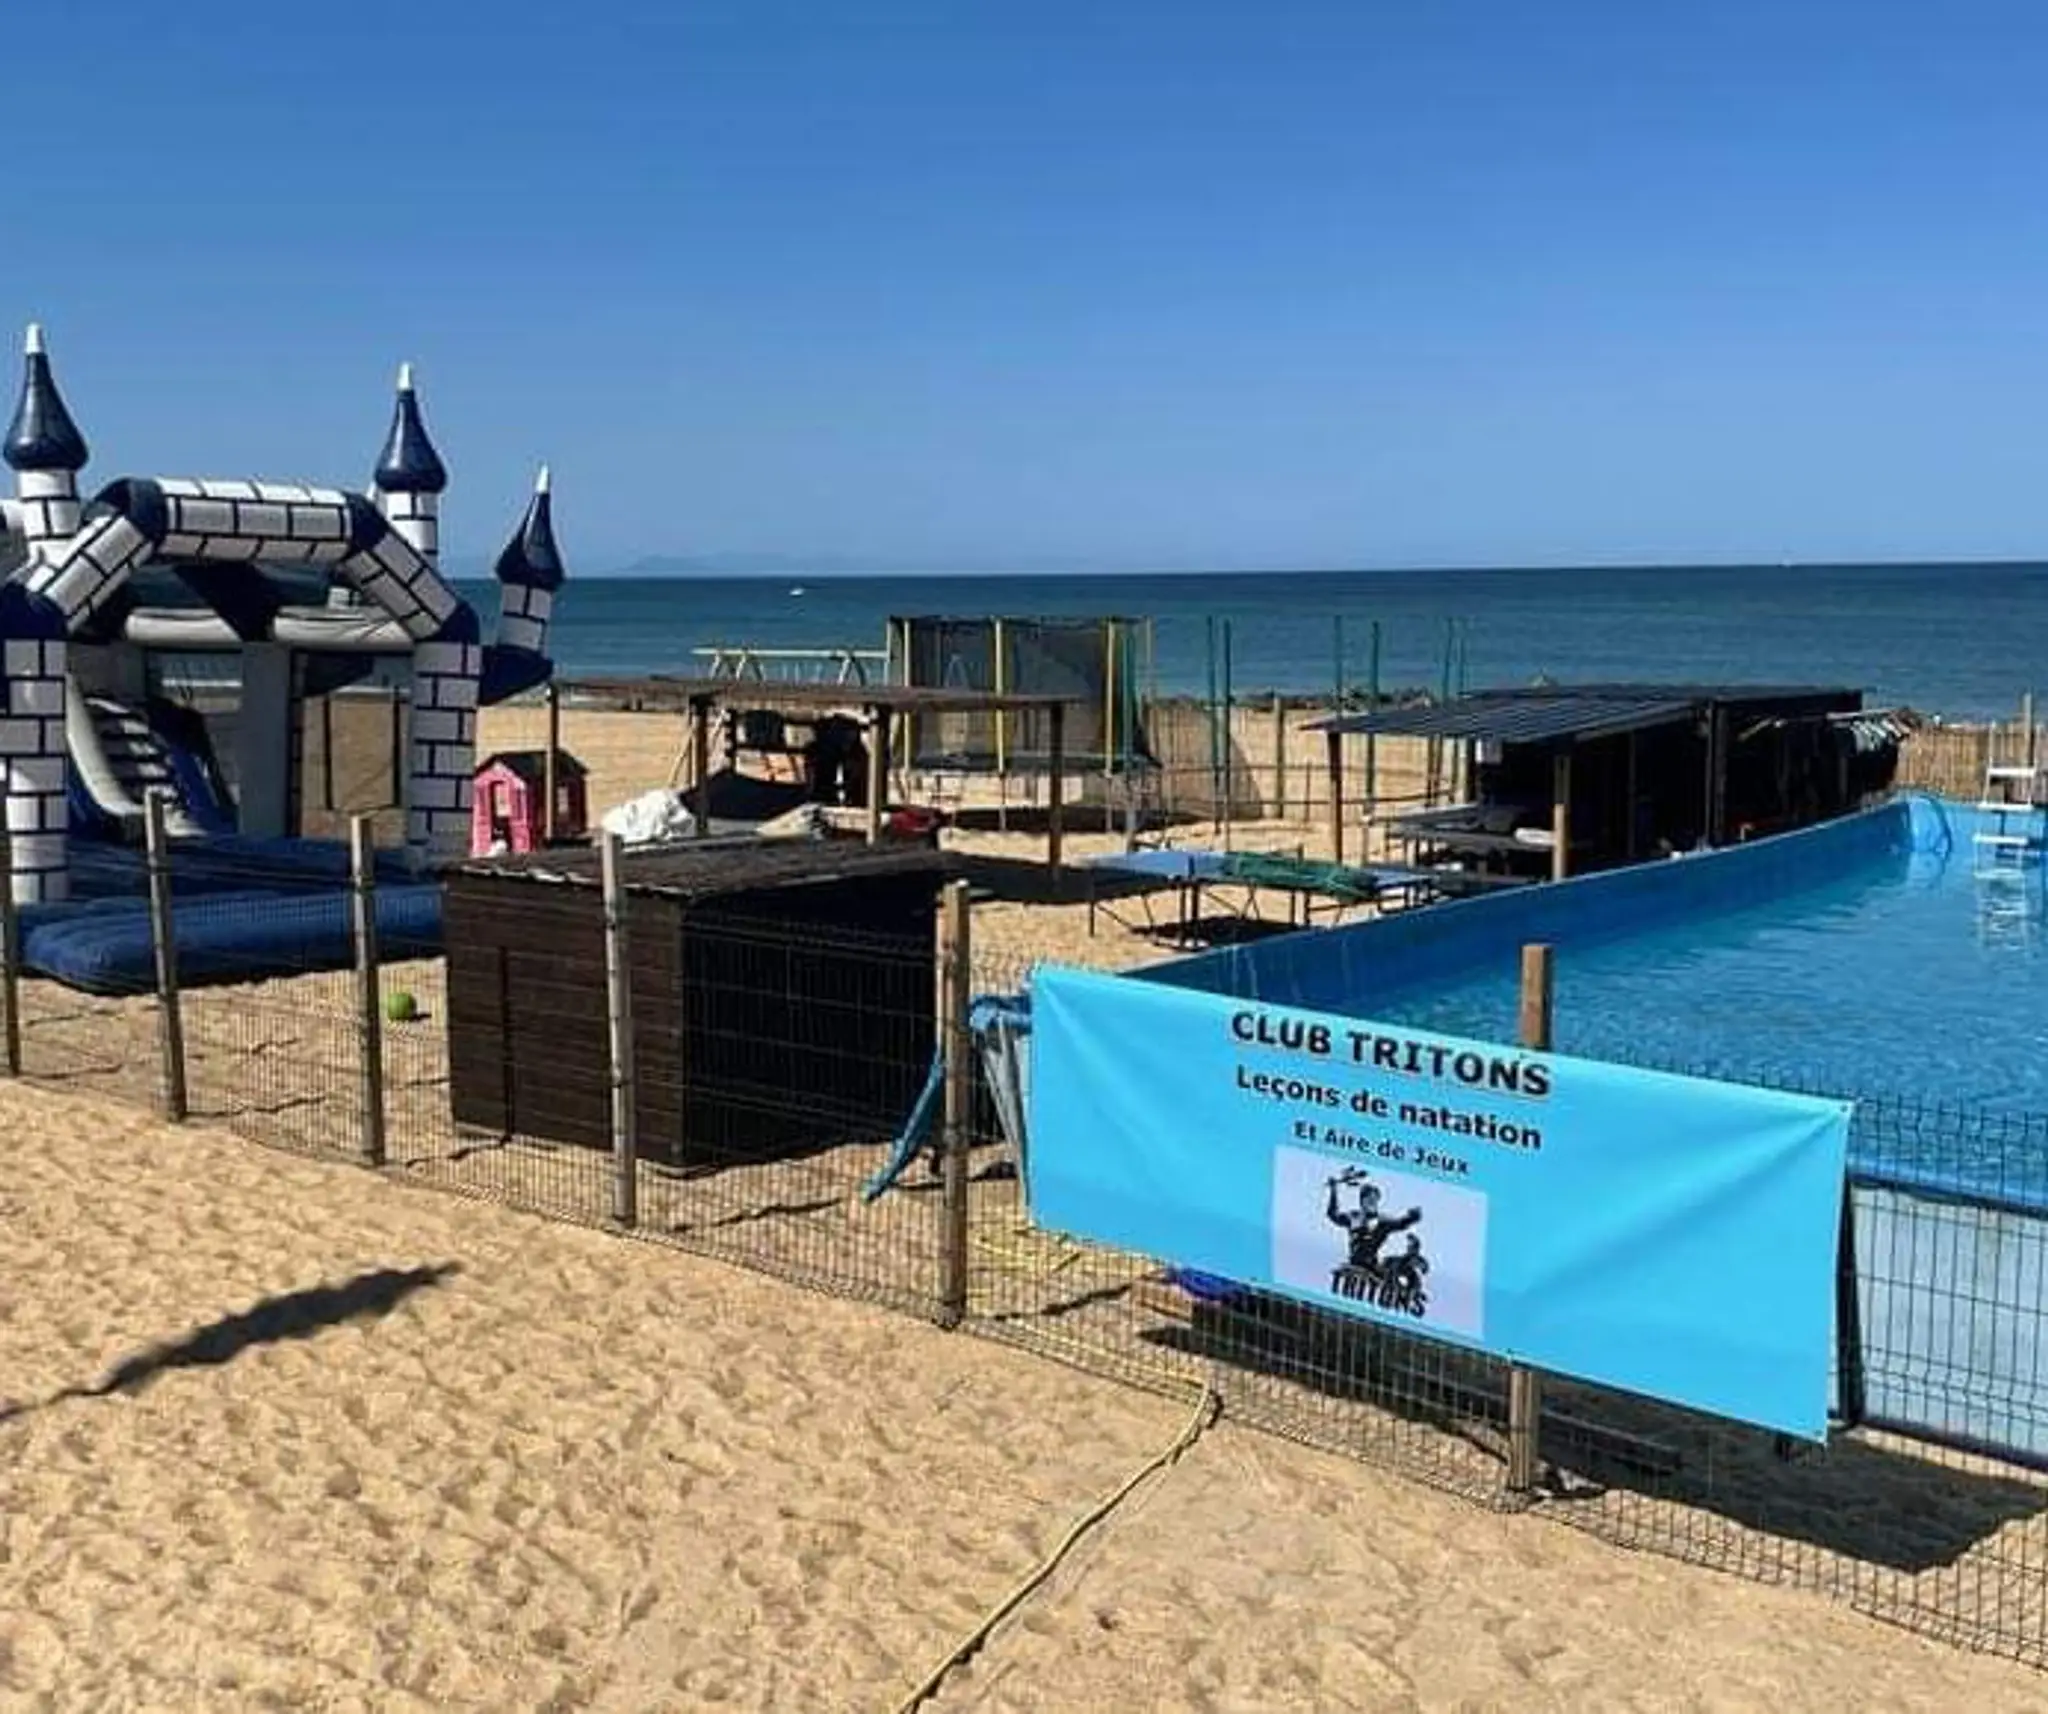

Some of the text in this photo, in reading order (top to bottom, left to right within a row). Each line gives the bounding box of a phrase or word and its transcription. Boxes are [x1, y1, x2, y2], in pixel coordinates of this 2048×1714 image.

[1232, 1010, 1550, 1095] CLUB TRITONS
[1236, 1064, 1541, 1150] Leçons de natation
[1294, 1120, 1469, 1174] Et Aire de Jeux
[1331, 1265, 1427, 1319] TRITONS
